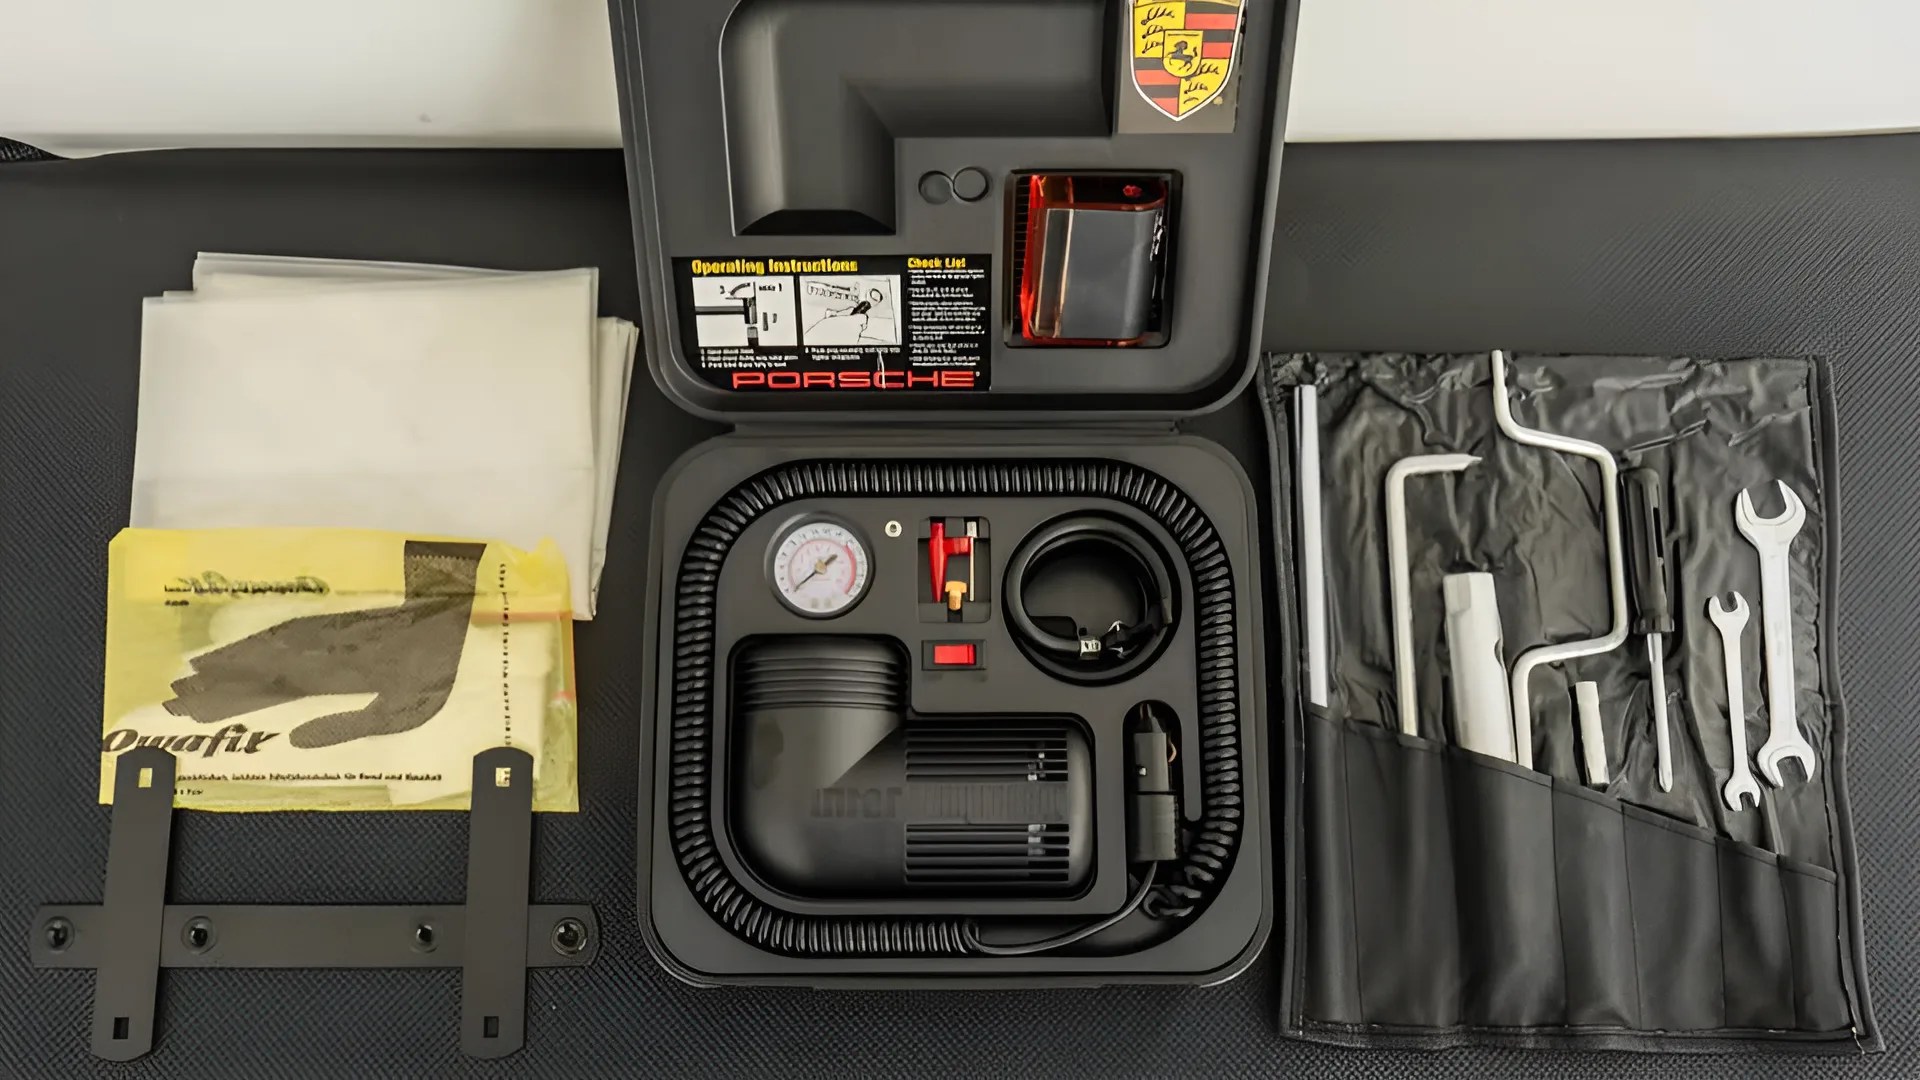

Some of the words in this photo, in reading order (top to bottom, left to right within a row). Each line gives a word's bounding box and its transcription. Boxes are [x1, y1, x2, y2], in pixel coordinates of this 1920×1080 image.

[691, 259, 765, 276] Operating
[769, 258, 858, 273] Instructions
[907, 257, 942, 269] Check
[945, 257, 966, 268] List
[732, 371, 975, 389] PORSCHE
